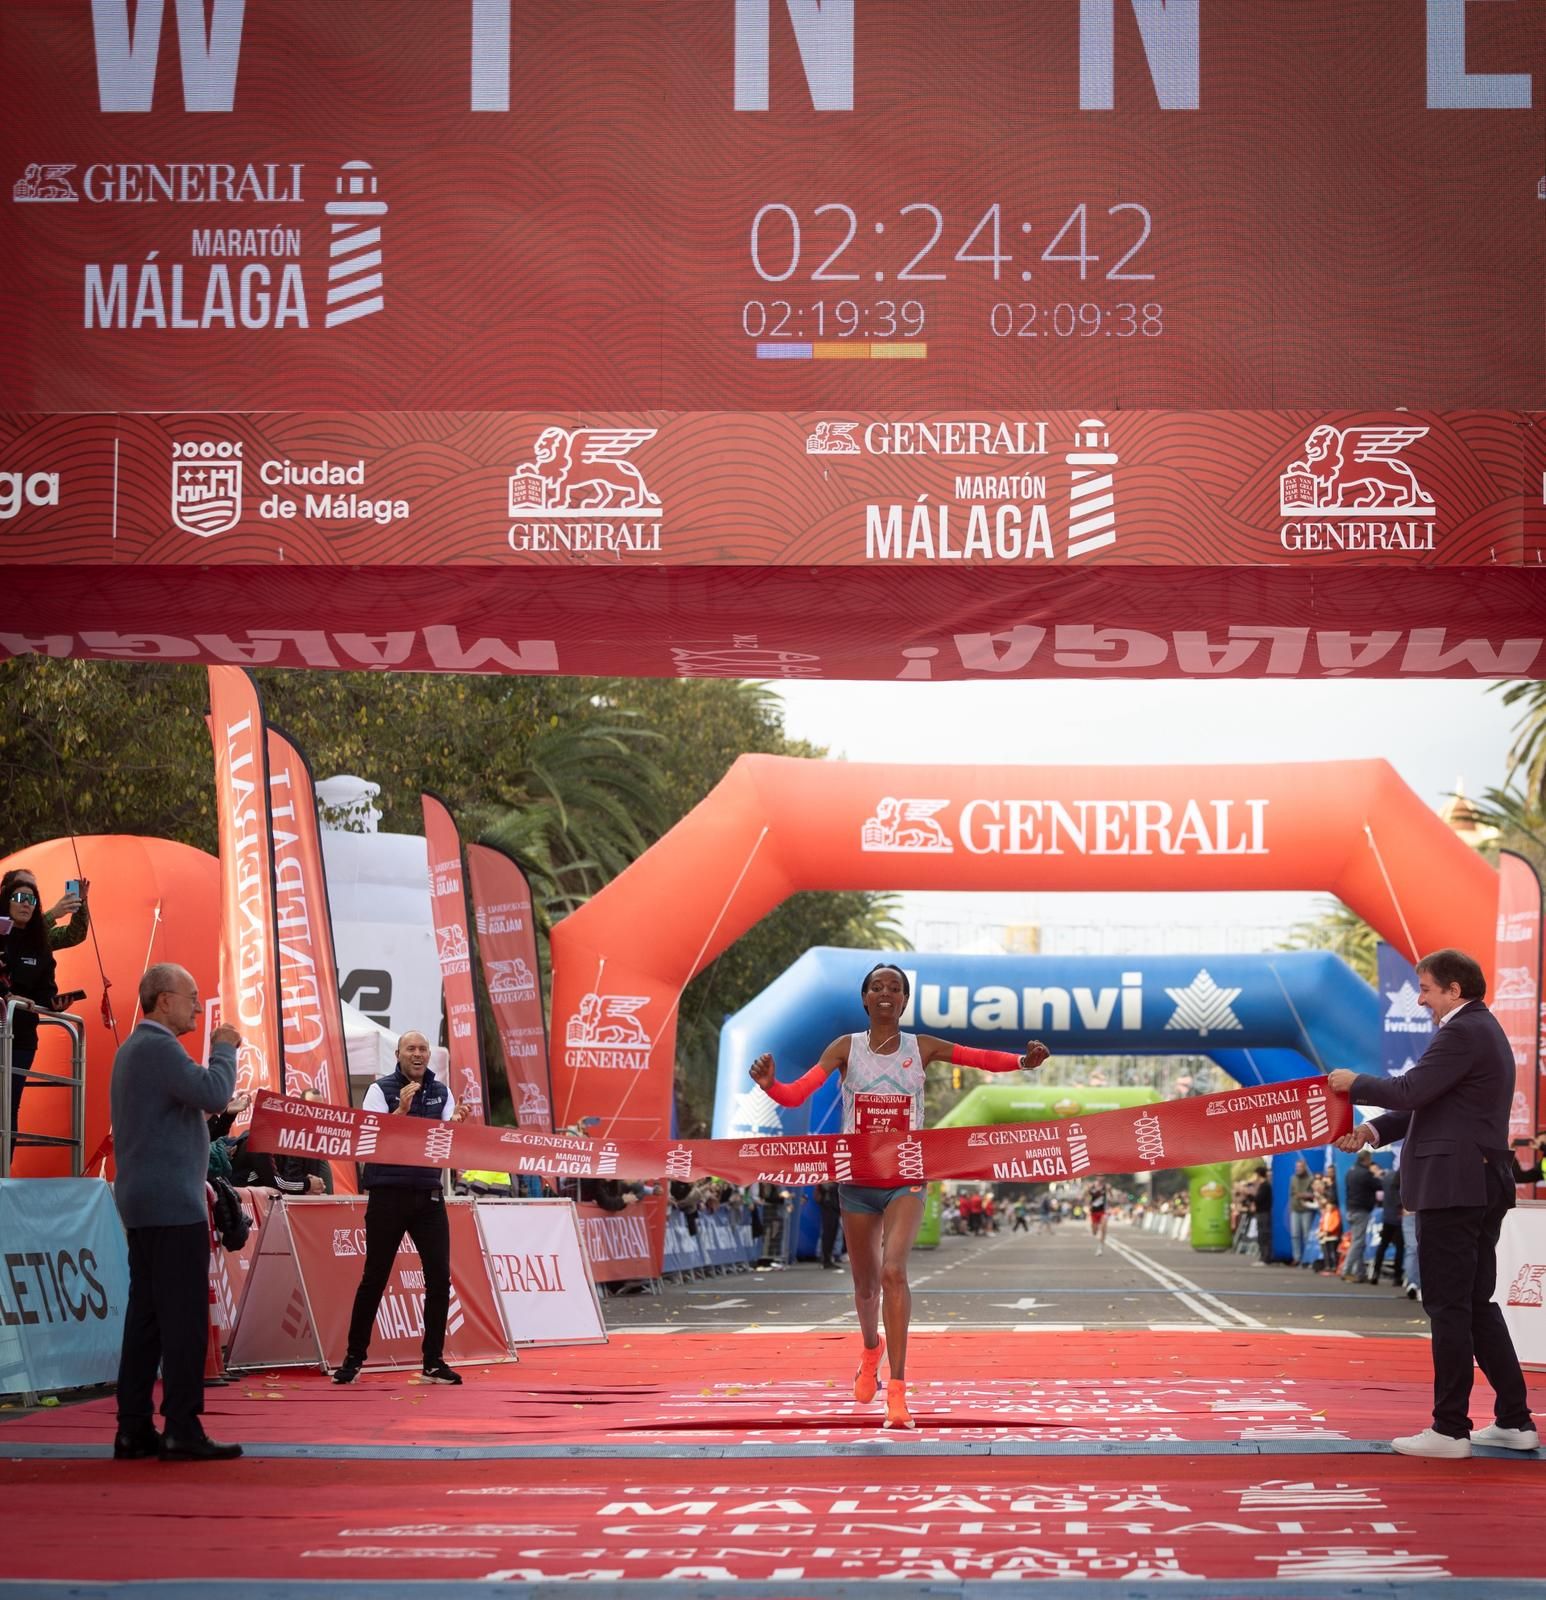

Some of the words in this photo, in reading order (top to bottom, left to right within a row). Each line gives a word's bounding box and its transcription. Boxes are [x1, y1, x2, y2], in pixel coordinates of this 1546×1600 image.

[83, 163, 305, 203] GENERALI
[191, 224, 301, 257] MARATÓN
[750, 203, 1155, 282] 02:24:42
[84, 251, 309, 329] MÁLAGA
[742, 301, 925, 338] 02:19:39
[990, 303, 1163, 338] 02:09:38
[864, 422, 1049, 455] GENERALI
[260, 460, 365, 485] Ciudad
[955, 472, 1046, 499] MARATÓN
[260, 493, 297, 519] de
[305, 492, 410, 524] Málaga
[508, 523, 663, 551] GENERALI
[866, 494, 1055, 559] MÁLAGA
[1280, 522, 1436, 550] GENERALI
[959, 799, 1270, 855] GENERALI
[565, 1049, 649, 1069] GENERALI
[284, 1101, 355, 1125] GENERALI
[1228, 1088, 1299, 1112] GENERALI
[1265, 1109, 1302, 1124] MARATÓN
[278, 1128, 351, 1157] MÁLAGA
[316, 1125, 352, 1138] MARATÓN
[523, 1134, 595, 1152] GENERALI
[989, 1127, 1061, 1145] GENERALI
[1233, 1120, 1308, 1153] MÁLAGA
[555, 1152, 592, 1163] MARATÓN
[760, 1141, 828, 1157] GENERALI
[1025, 1146, 1062, 1159] MARATÓN
[519, 1156, 593, 1175] MÁLAGA
[794, 1161, 828, 1172] MARATÓN
[993, 1157, 1068, 1179] MÁLAGA
[587, 1216, 650, 1262] GENERALI
[376, 1285, 426, 1340] MÁLA
[602, 1521, 1417, 1536] GENERALI
